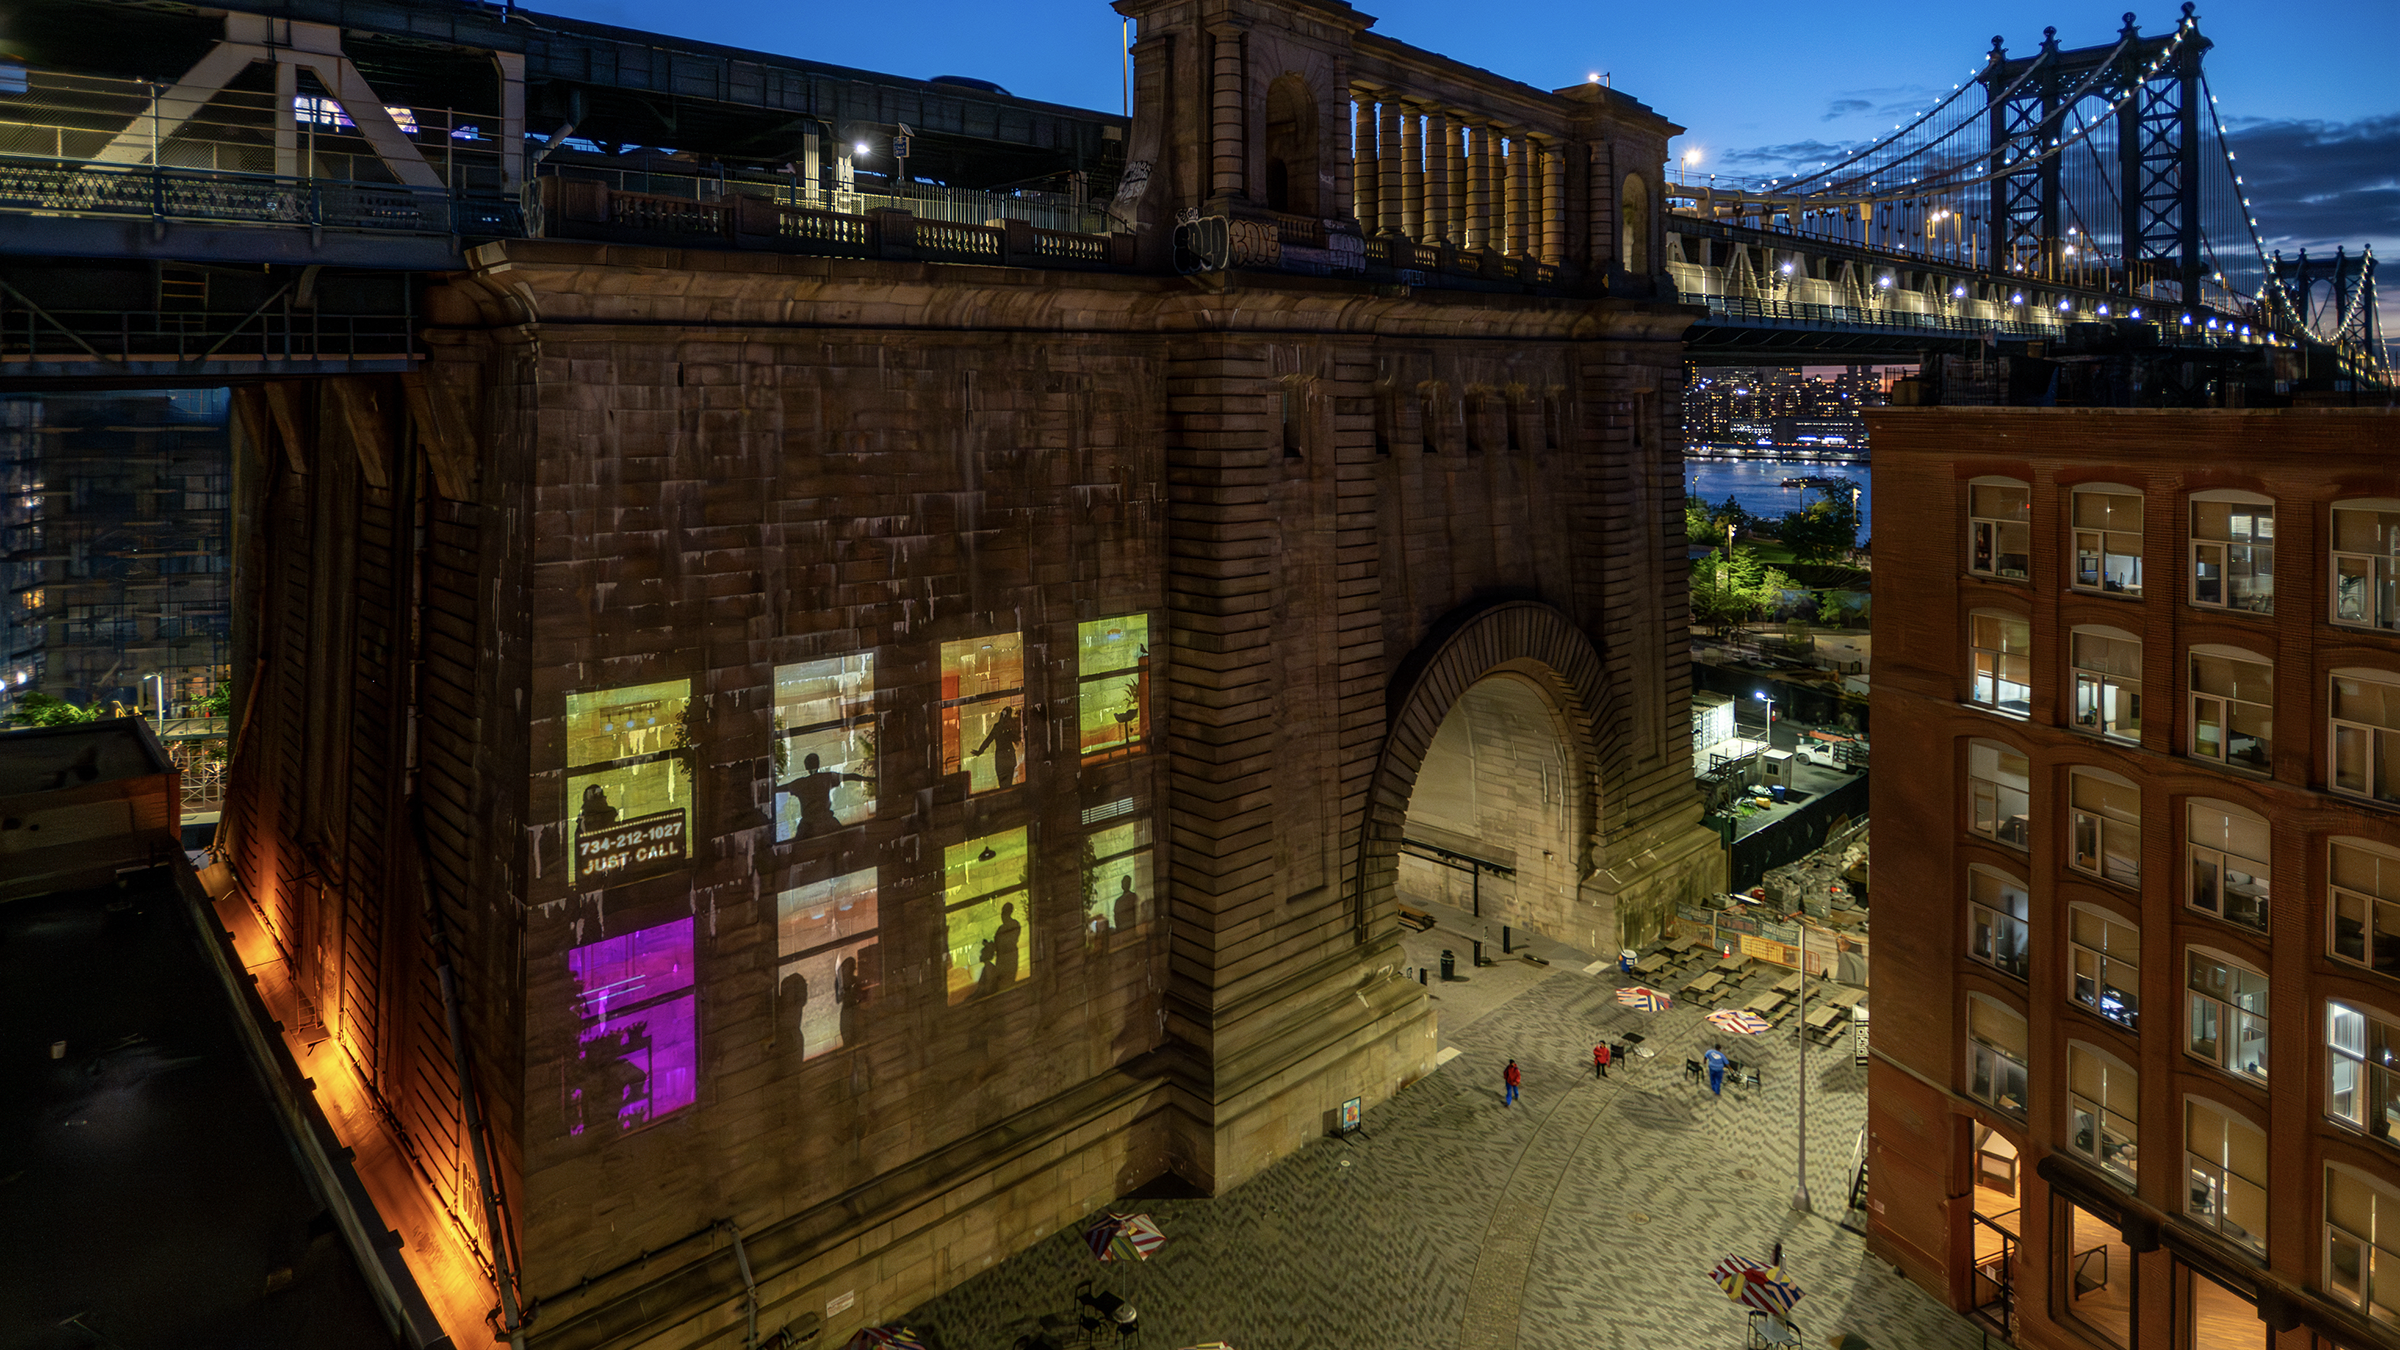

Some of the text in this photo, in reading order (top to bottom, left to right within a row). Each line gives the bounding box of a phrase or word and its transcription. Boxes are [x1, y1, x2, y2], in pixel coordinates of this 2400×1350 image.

[580, 822, 682, 856] 734-212-1027
[582, 841, 679, 875] JUST CALL
